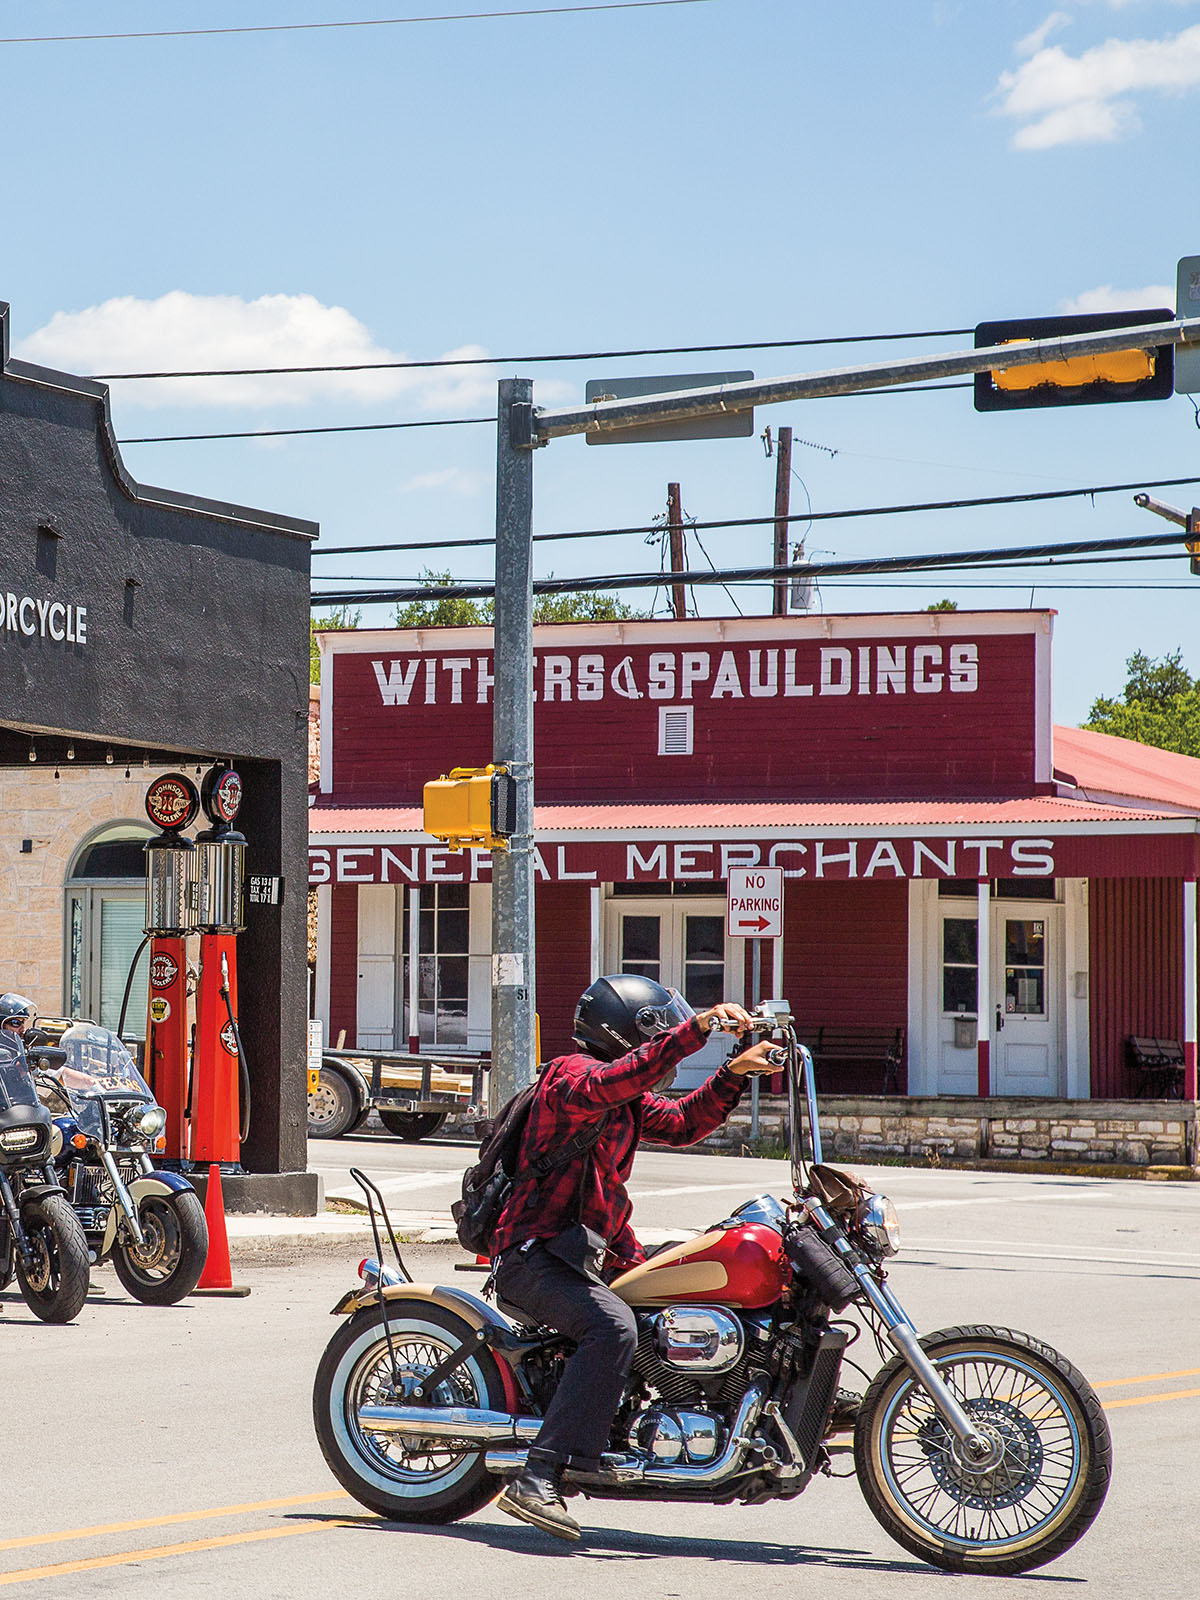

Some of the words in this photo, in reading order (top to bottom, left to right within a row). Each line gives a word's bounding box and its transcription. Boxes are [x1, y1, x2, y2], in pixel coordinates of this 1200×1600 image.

[371, 654, 605, 705] WITRS
[648, 643, 979, 699] SPAULDINGS
[155, 784, 184, 798] JOHNSON
[250, 876, 261, 886] GAS
[745, 875, 766, 889] NO
[731, 898, 780, 912] PARKING
[97, 1075, 143, 1093] TEXAS
